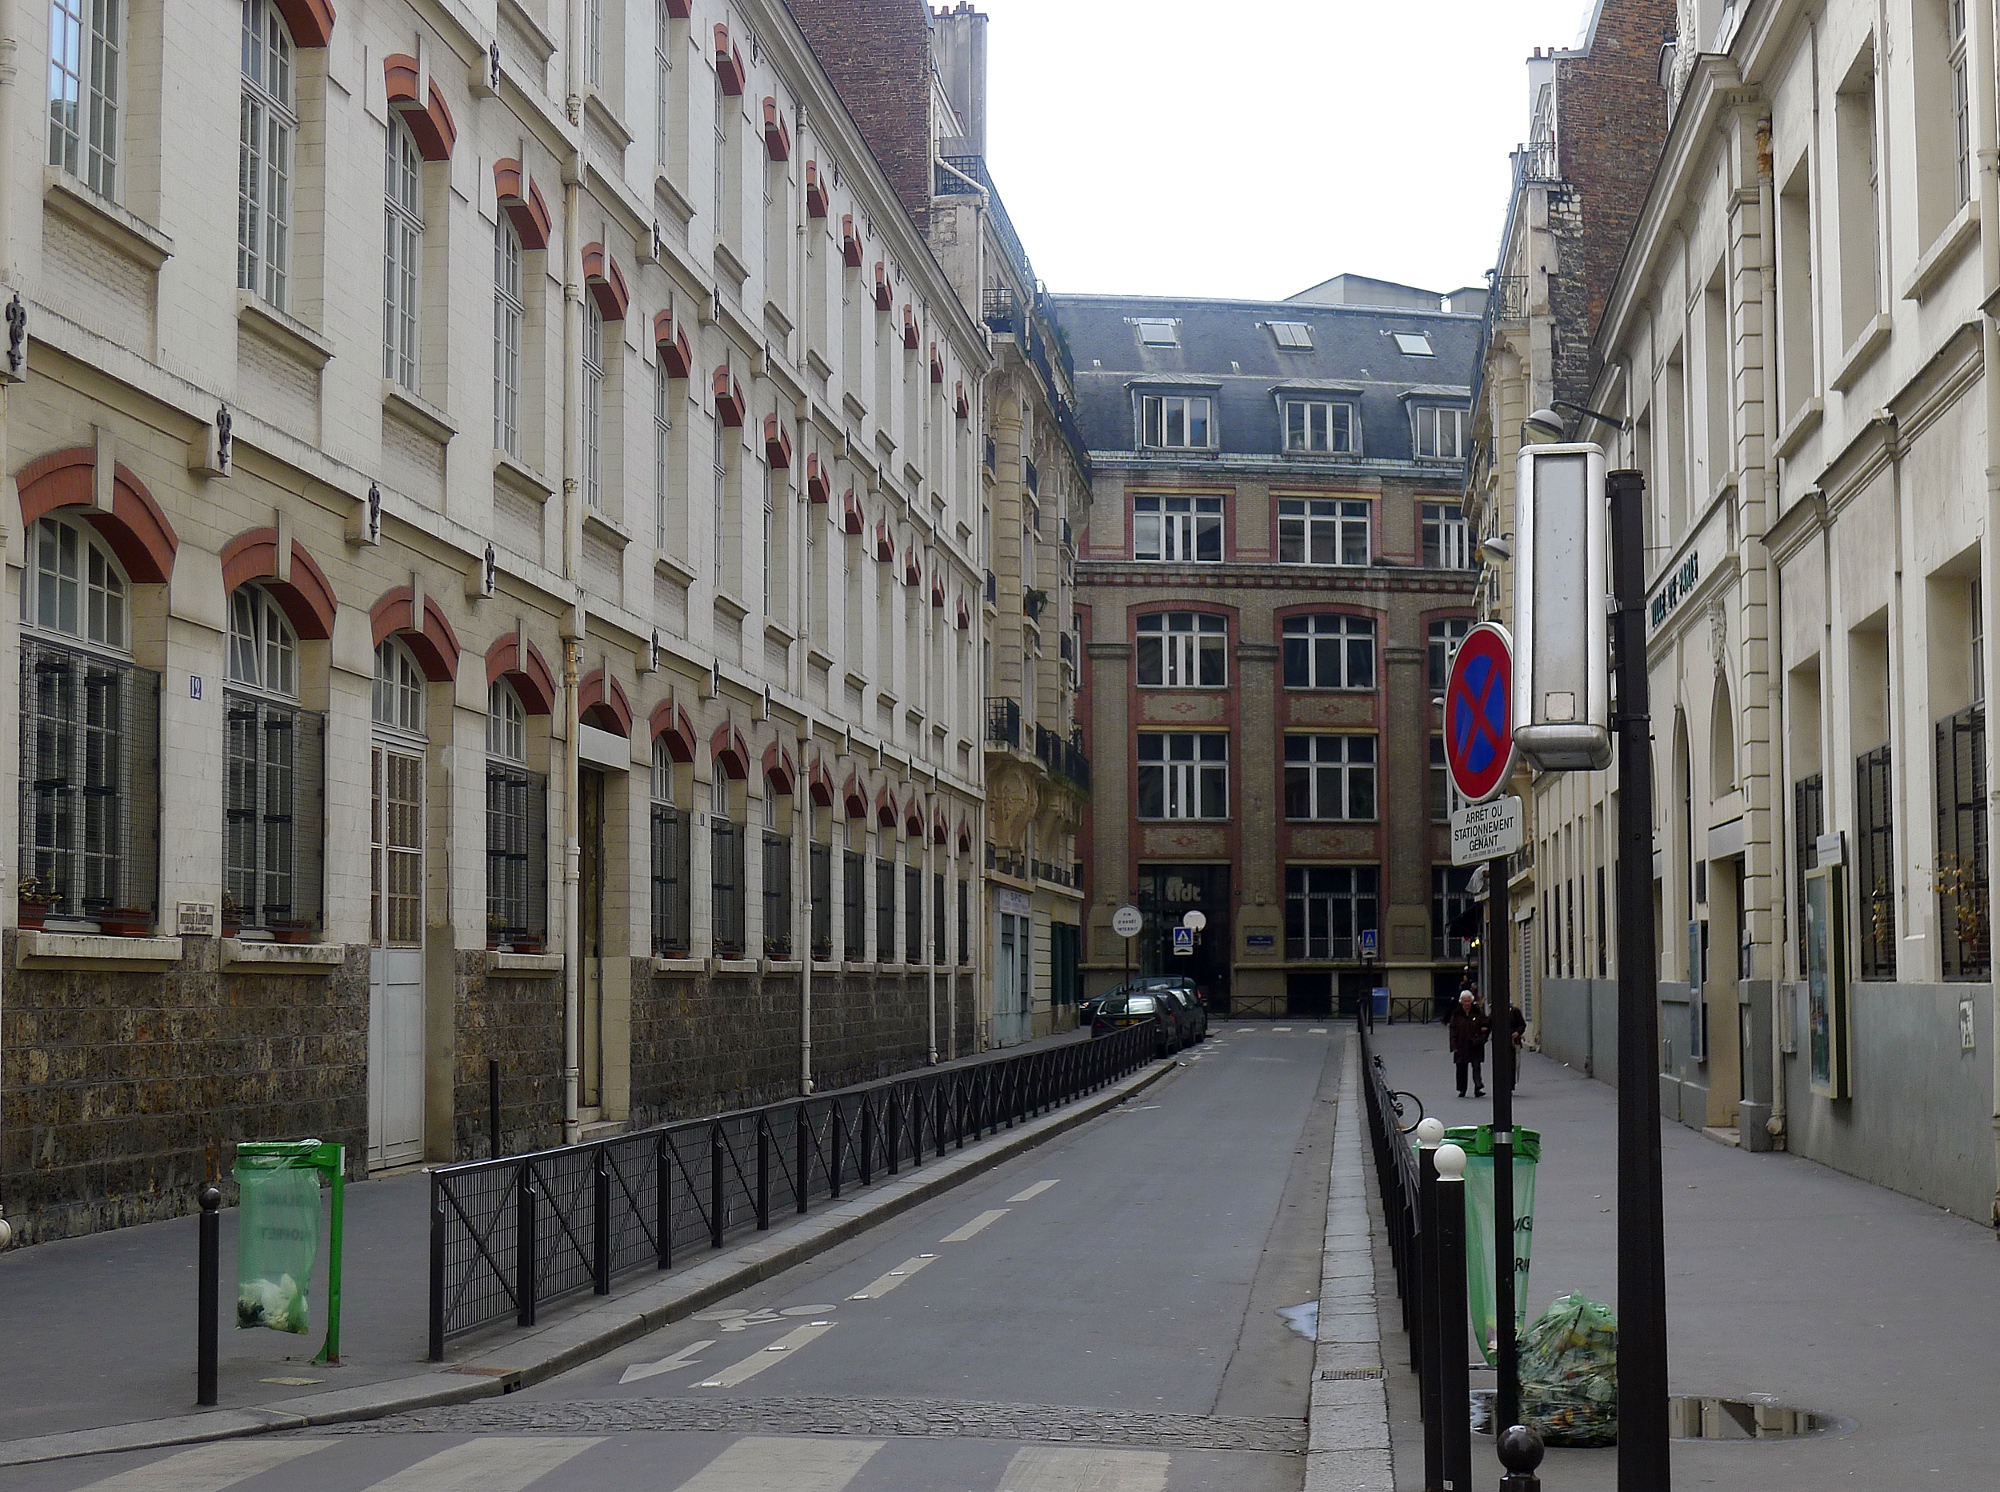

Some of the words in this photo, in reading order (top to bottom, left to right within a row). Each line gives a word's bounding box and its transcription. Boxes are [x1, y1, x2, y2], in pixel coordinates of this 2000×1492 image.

[191, 676, 201, 698] 12
[1465, 807, 1488, 825] ARRÊT
[1491, 805, 1503, 818] OU
[1454, 816, 1514, 841] STATIONNEMENT
